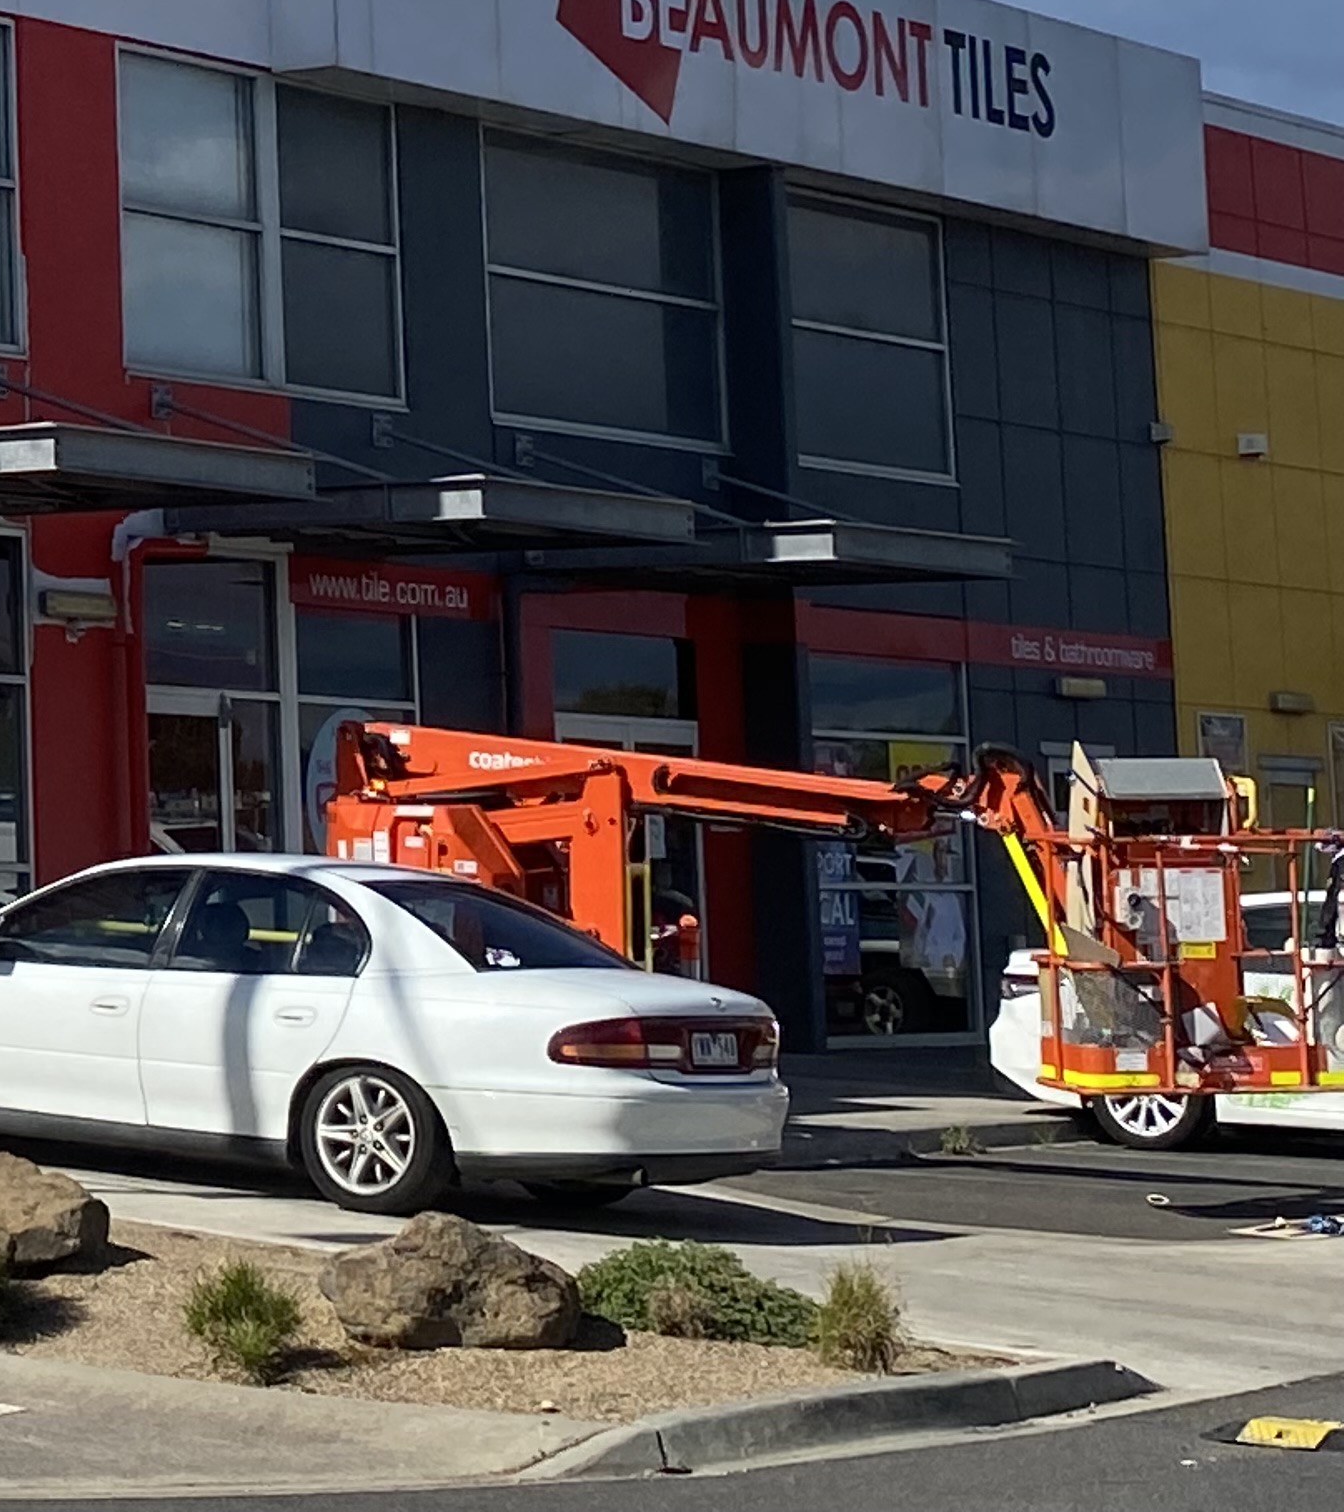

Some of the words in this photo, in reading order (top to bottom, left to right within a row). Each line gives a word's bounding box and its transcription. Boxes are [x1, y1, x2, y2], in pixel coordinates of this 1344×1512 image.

[942, 26, 1056, 139] TILES
[308, 569, 469, 609] www.tile.com.au
[1043, 635, 1057, 663] &
